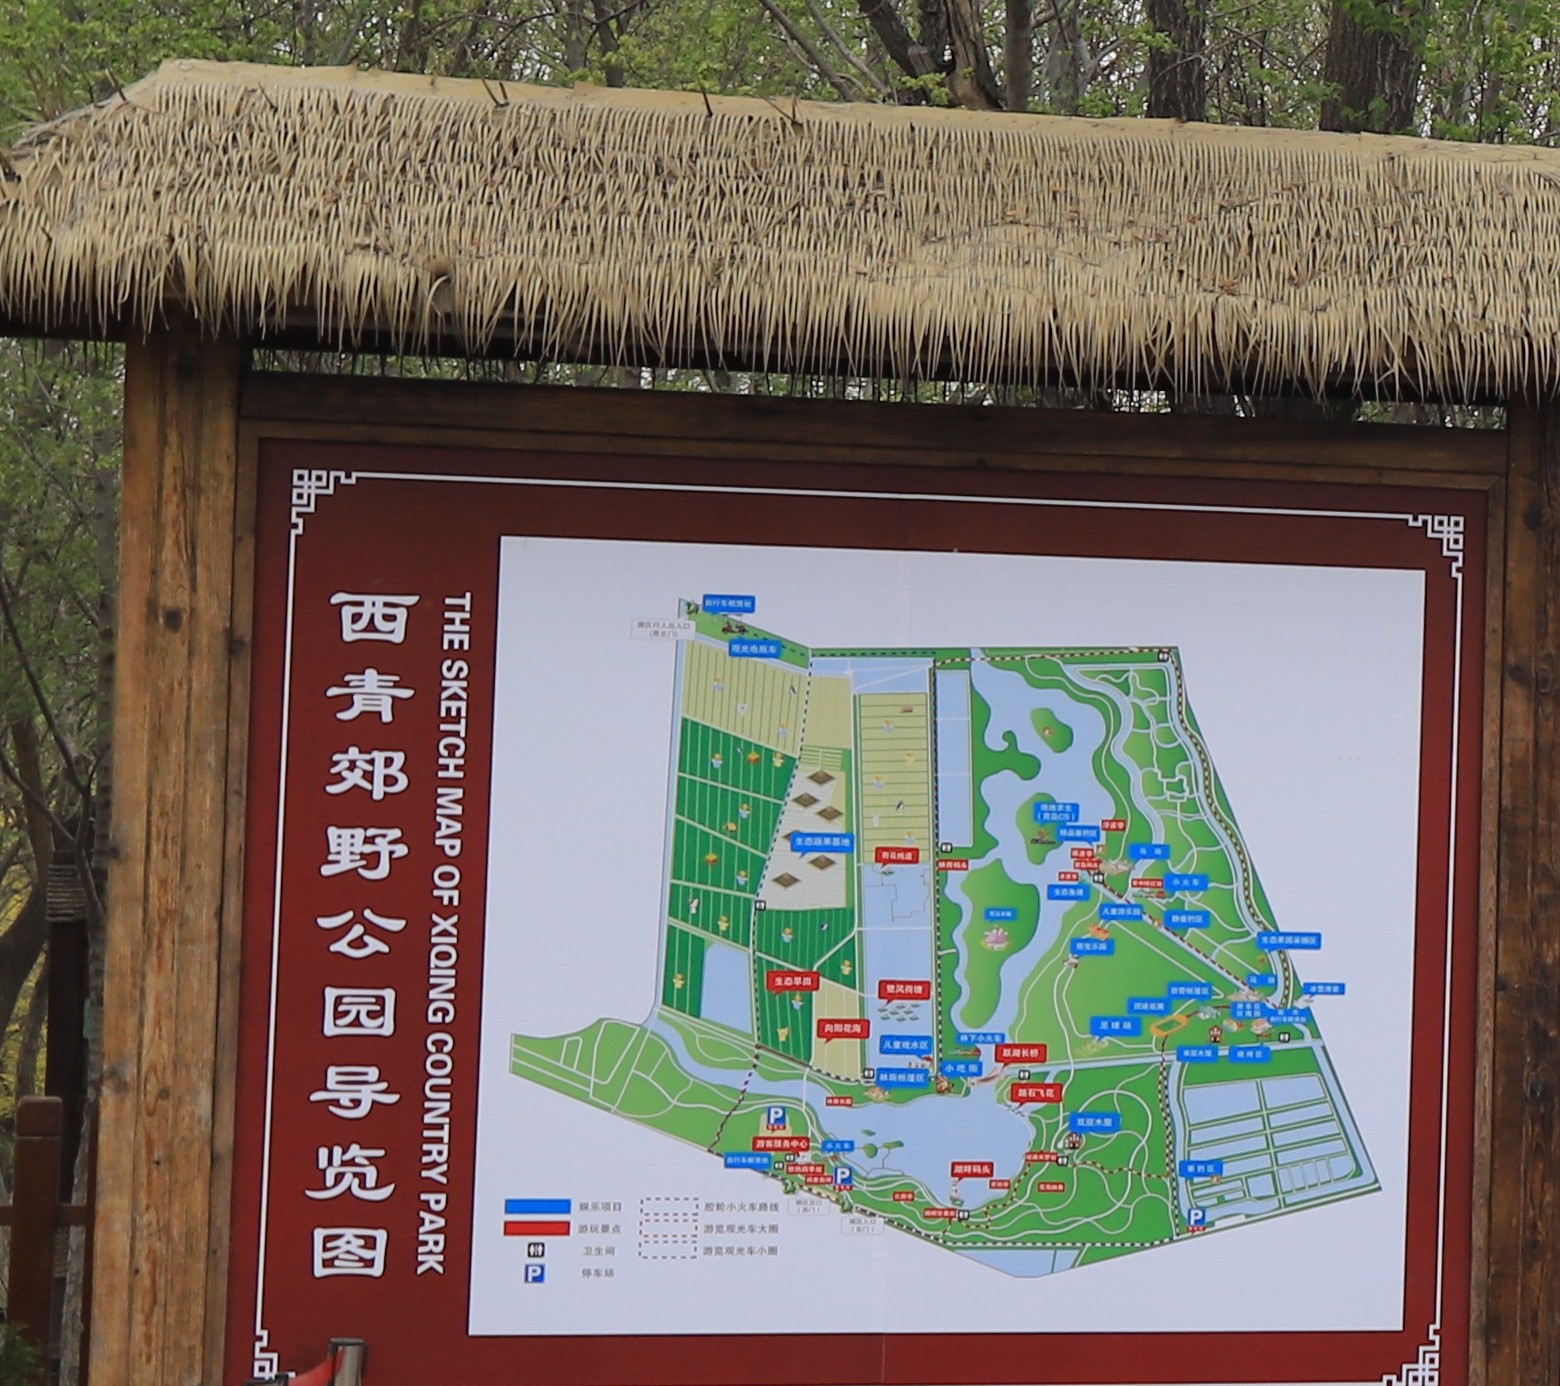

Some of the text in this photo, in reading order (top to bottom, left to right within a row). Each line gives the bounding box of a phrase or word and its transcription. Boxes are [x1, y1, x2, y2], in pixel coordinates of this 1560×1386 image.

[305, 592, 420, 1279] 西青郊野公园导览图
[416, 592, 471, 1277] THE SKETCH MAP OF XIQING COUNTRY PARK
[579, 1202, 622, 1212] 娱乐项目
[578, 1224, 621, 1234] 游玩景点
[583, 1246, 615, 1256] 卫生间
[582, 1268, 615, 1278] 停车场
